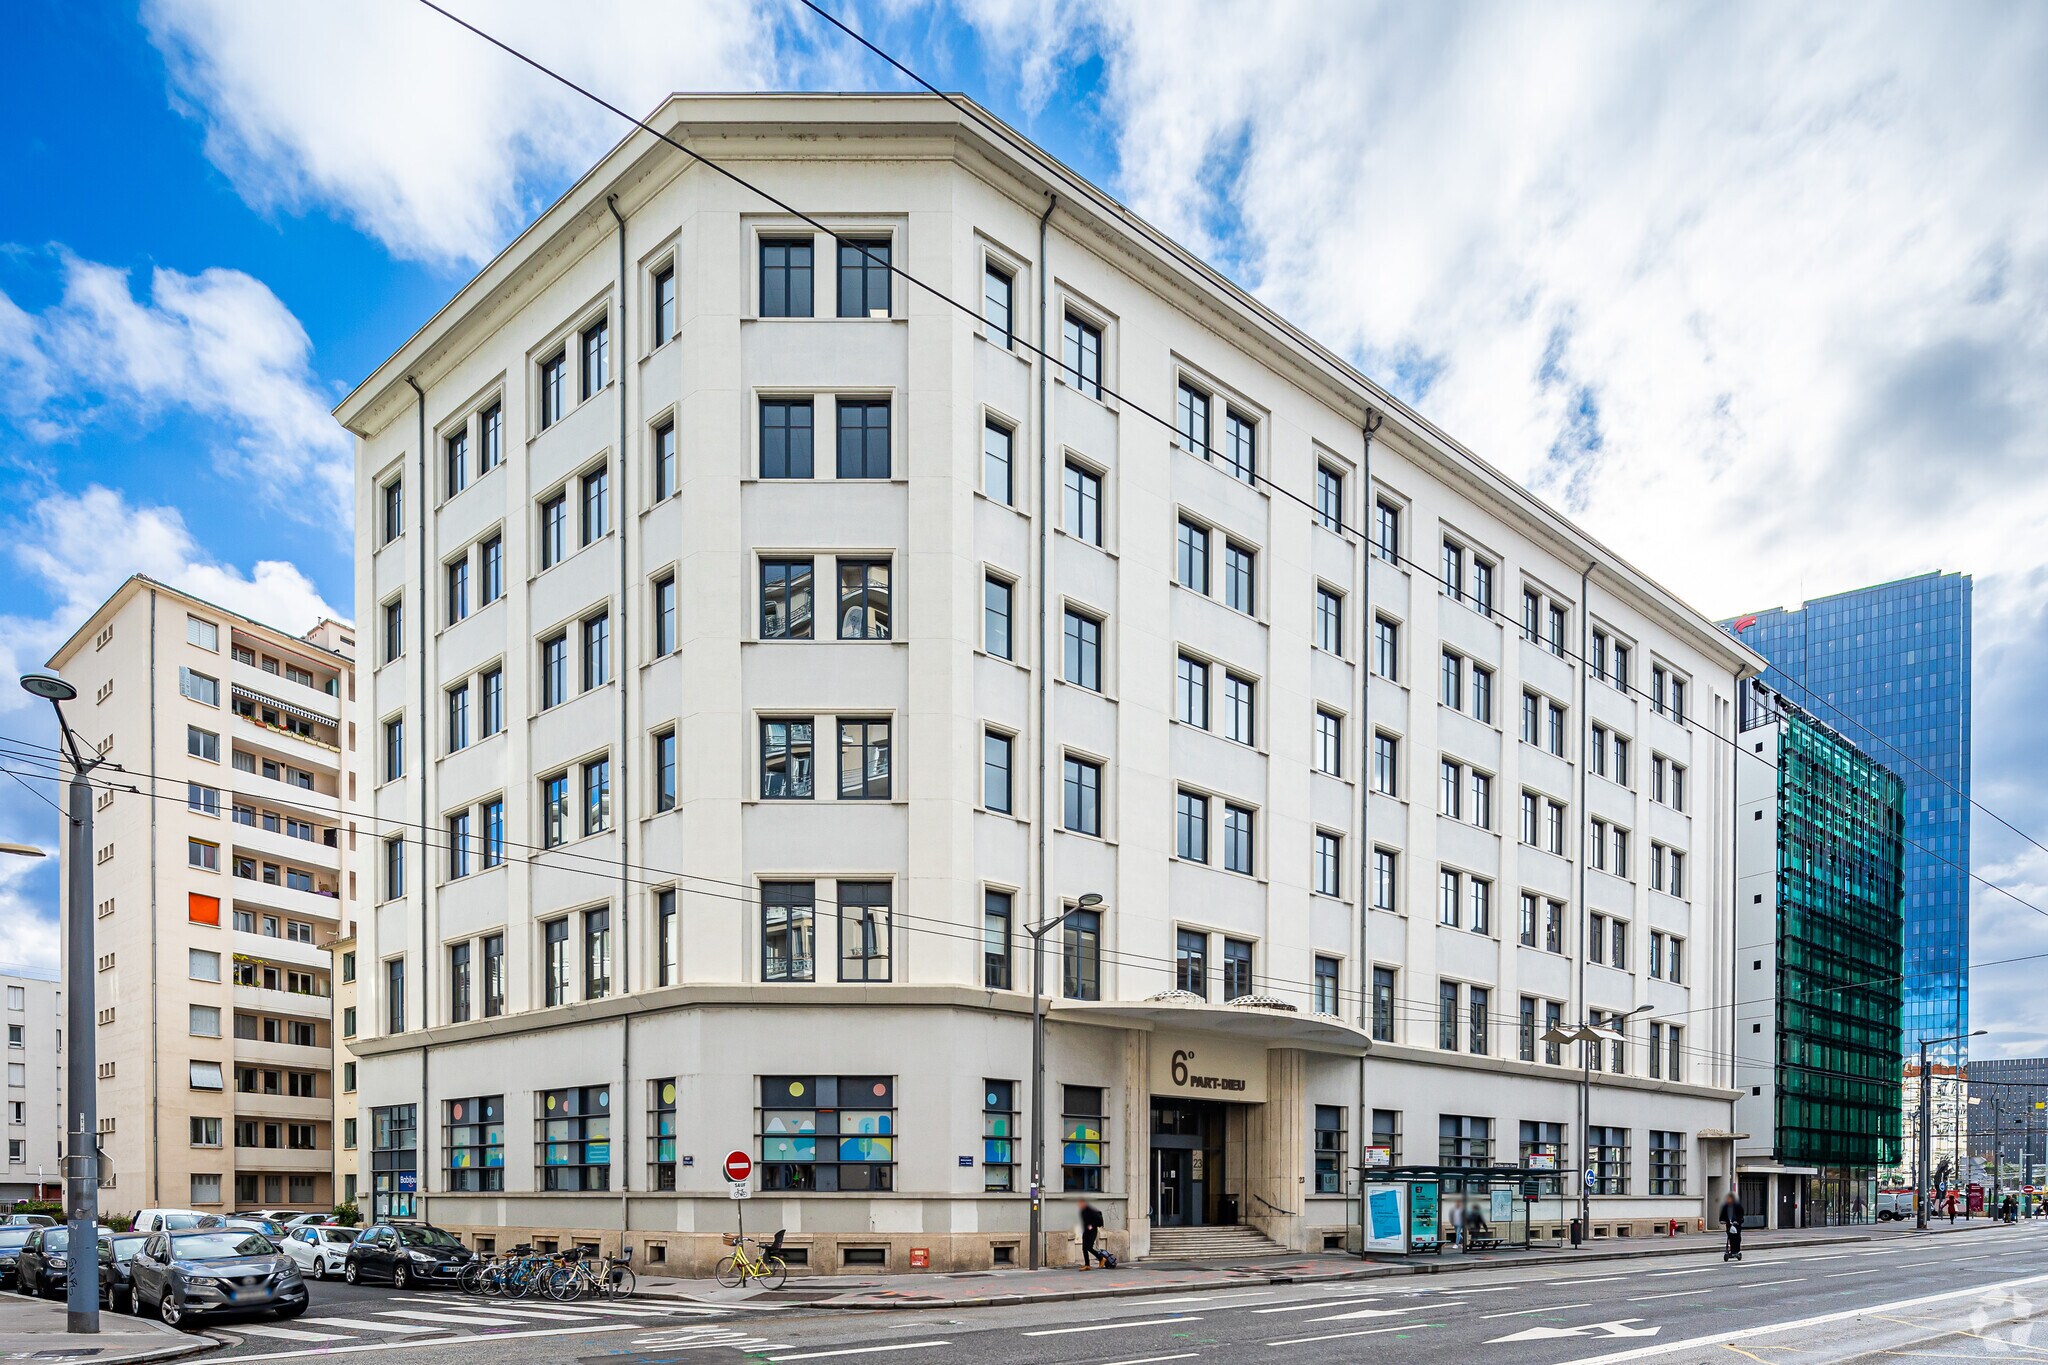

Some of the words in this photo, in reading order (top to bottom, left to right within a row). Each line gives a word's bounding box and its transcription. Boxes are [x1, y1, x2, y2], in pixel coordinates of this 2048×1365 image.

[1190, 1075, 1246, 1092] PART-DIEU
[1193, 1158, 1203, 1168] 23
[1299, 1176, 1305, 1184] 23
